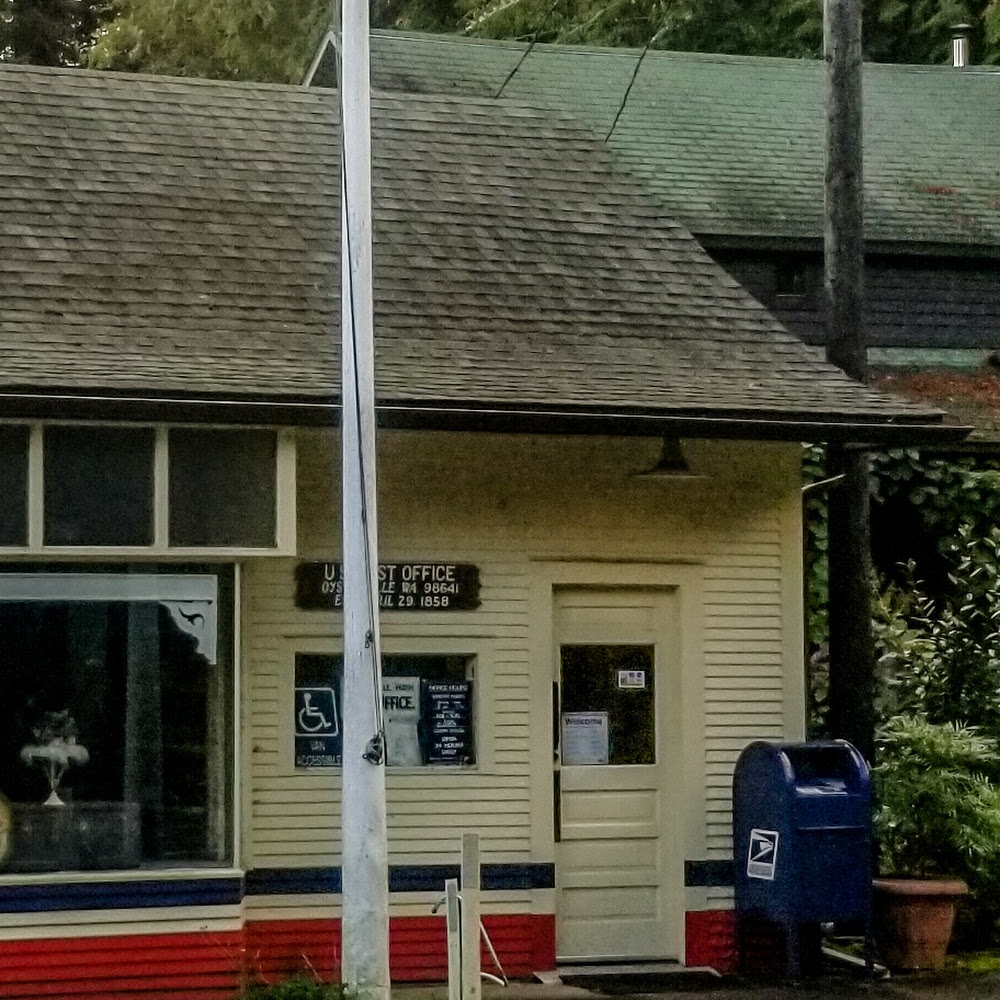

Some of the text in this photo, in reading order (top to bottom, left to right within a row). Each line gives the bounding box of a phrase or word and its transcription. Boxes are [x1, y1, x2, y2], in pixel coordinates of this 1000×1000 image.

[324, 563, 335, 581] U
[402, 565, 456, 582] OFFICE
[424, 583, 459, 594] 98641
